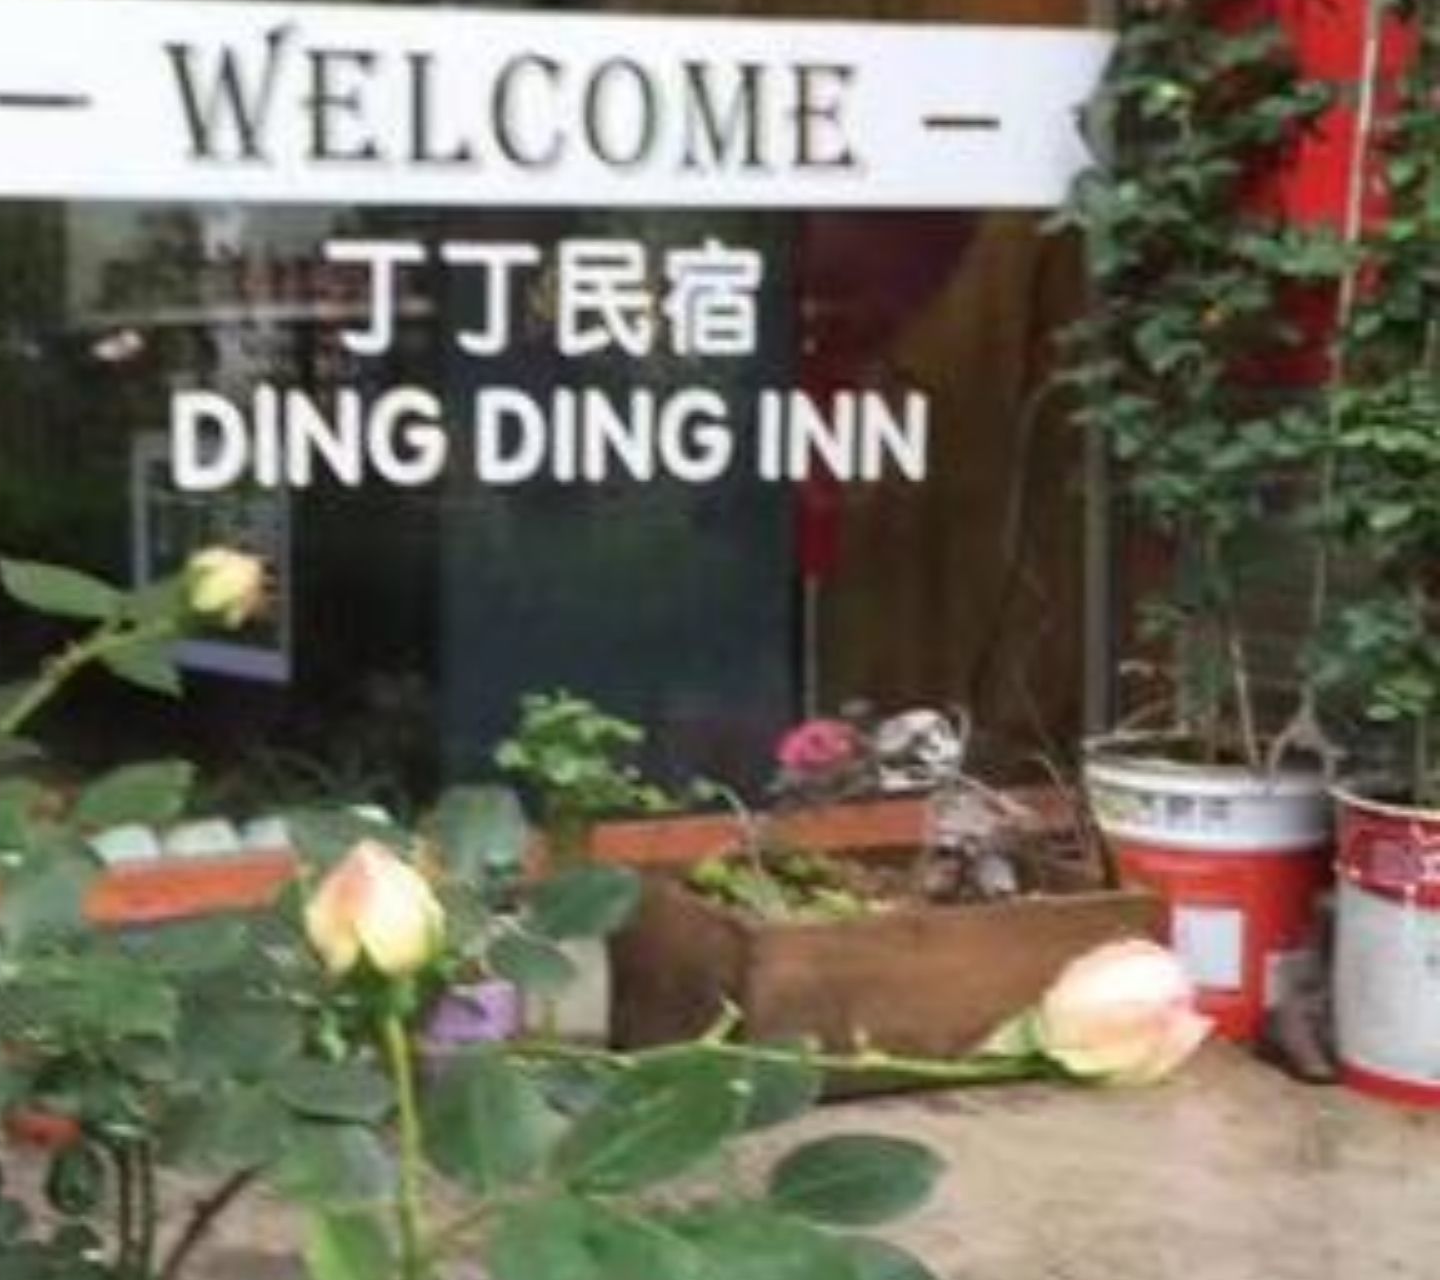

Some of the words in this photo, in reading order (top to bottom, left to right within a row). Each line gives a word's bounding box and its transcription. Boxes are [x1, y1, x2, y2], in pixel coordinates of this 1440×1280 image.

[163, 21, 864, 172] WELCOME
[323, 237, 763, 357] 丁丁民宿
[170, 384, 446, 491] DING
[474, 386, 733, 484] DING
[759, 389, 928, 482] INN
